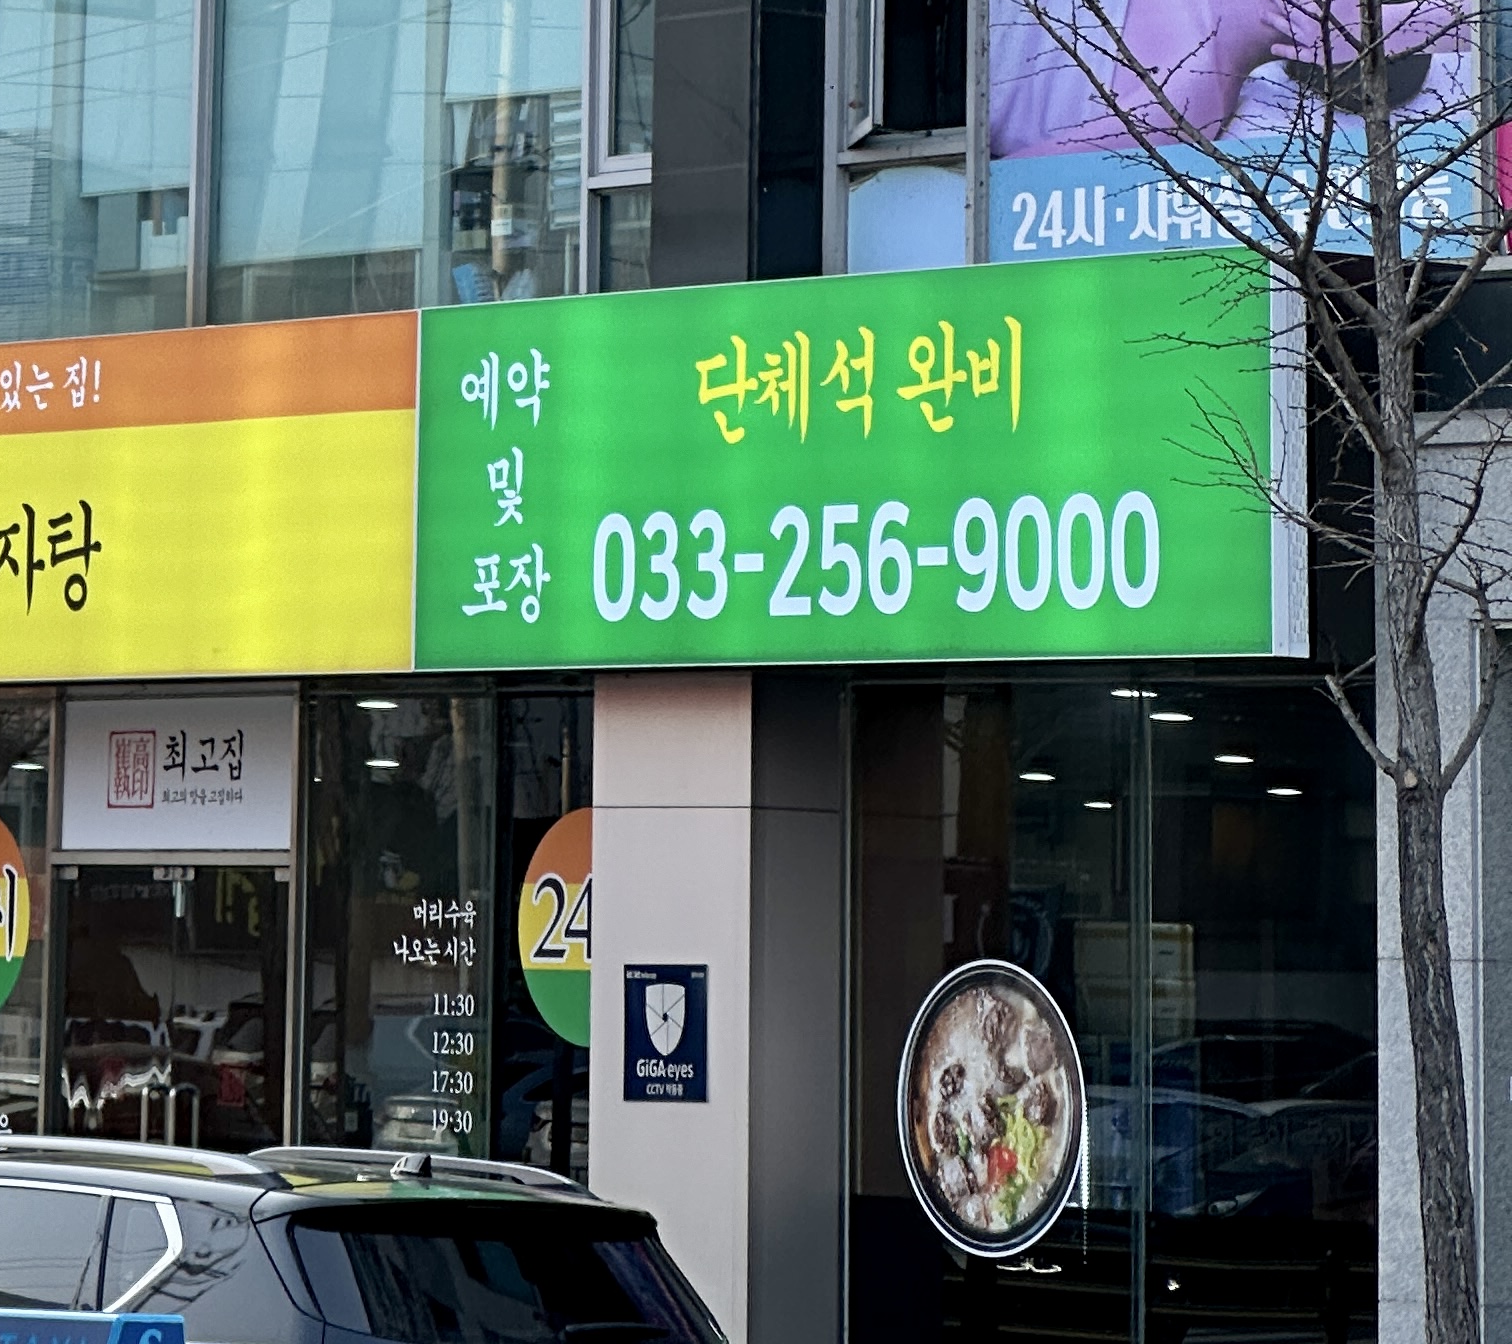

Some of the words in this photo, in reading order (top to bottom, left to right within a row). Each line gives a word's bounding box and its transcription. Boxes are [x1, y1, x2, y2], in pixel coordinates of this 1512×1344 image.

[63, 358, 104, 411] 집!
[459, 347, 551, 431] 예약
[695, 325, 877, 444] 단체석
[897, 316, 1023, 433] 완비
[487, 447, 525, 526] 및
[592, 491, 1161, 622] 033-256-9000
[461, 552, 551, 624] 포장
[162, 729, 244, 782] 최고집
[413, 899, 477, 929] 머리수육
[393, 935, 440, 966] 나오는
[443, 936, 476, 966] 시간
[433, 993, 475, 1016] 11:30
[431, 1031, 474, 1055] 12:30
[431, 1070, 474, 1094] 17:30
[636, 1058, 667, 1078] GiGA
[667, 1063, 694, 1081] eyes
[646, 1083, 664, 1095] CCTV
